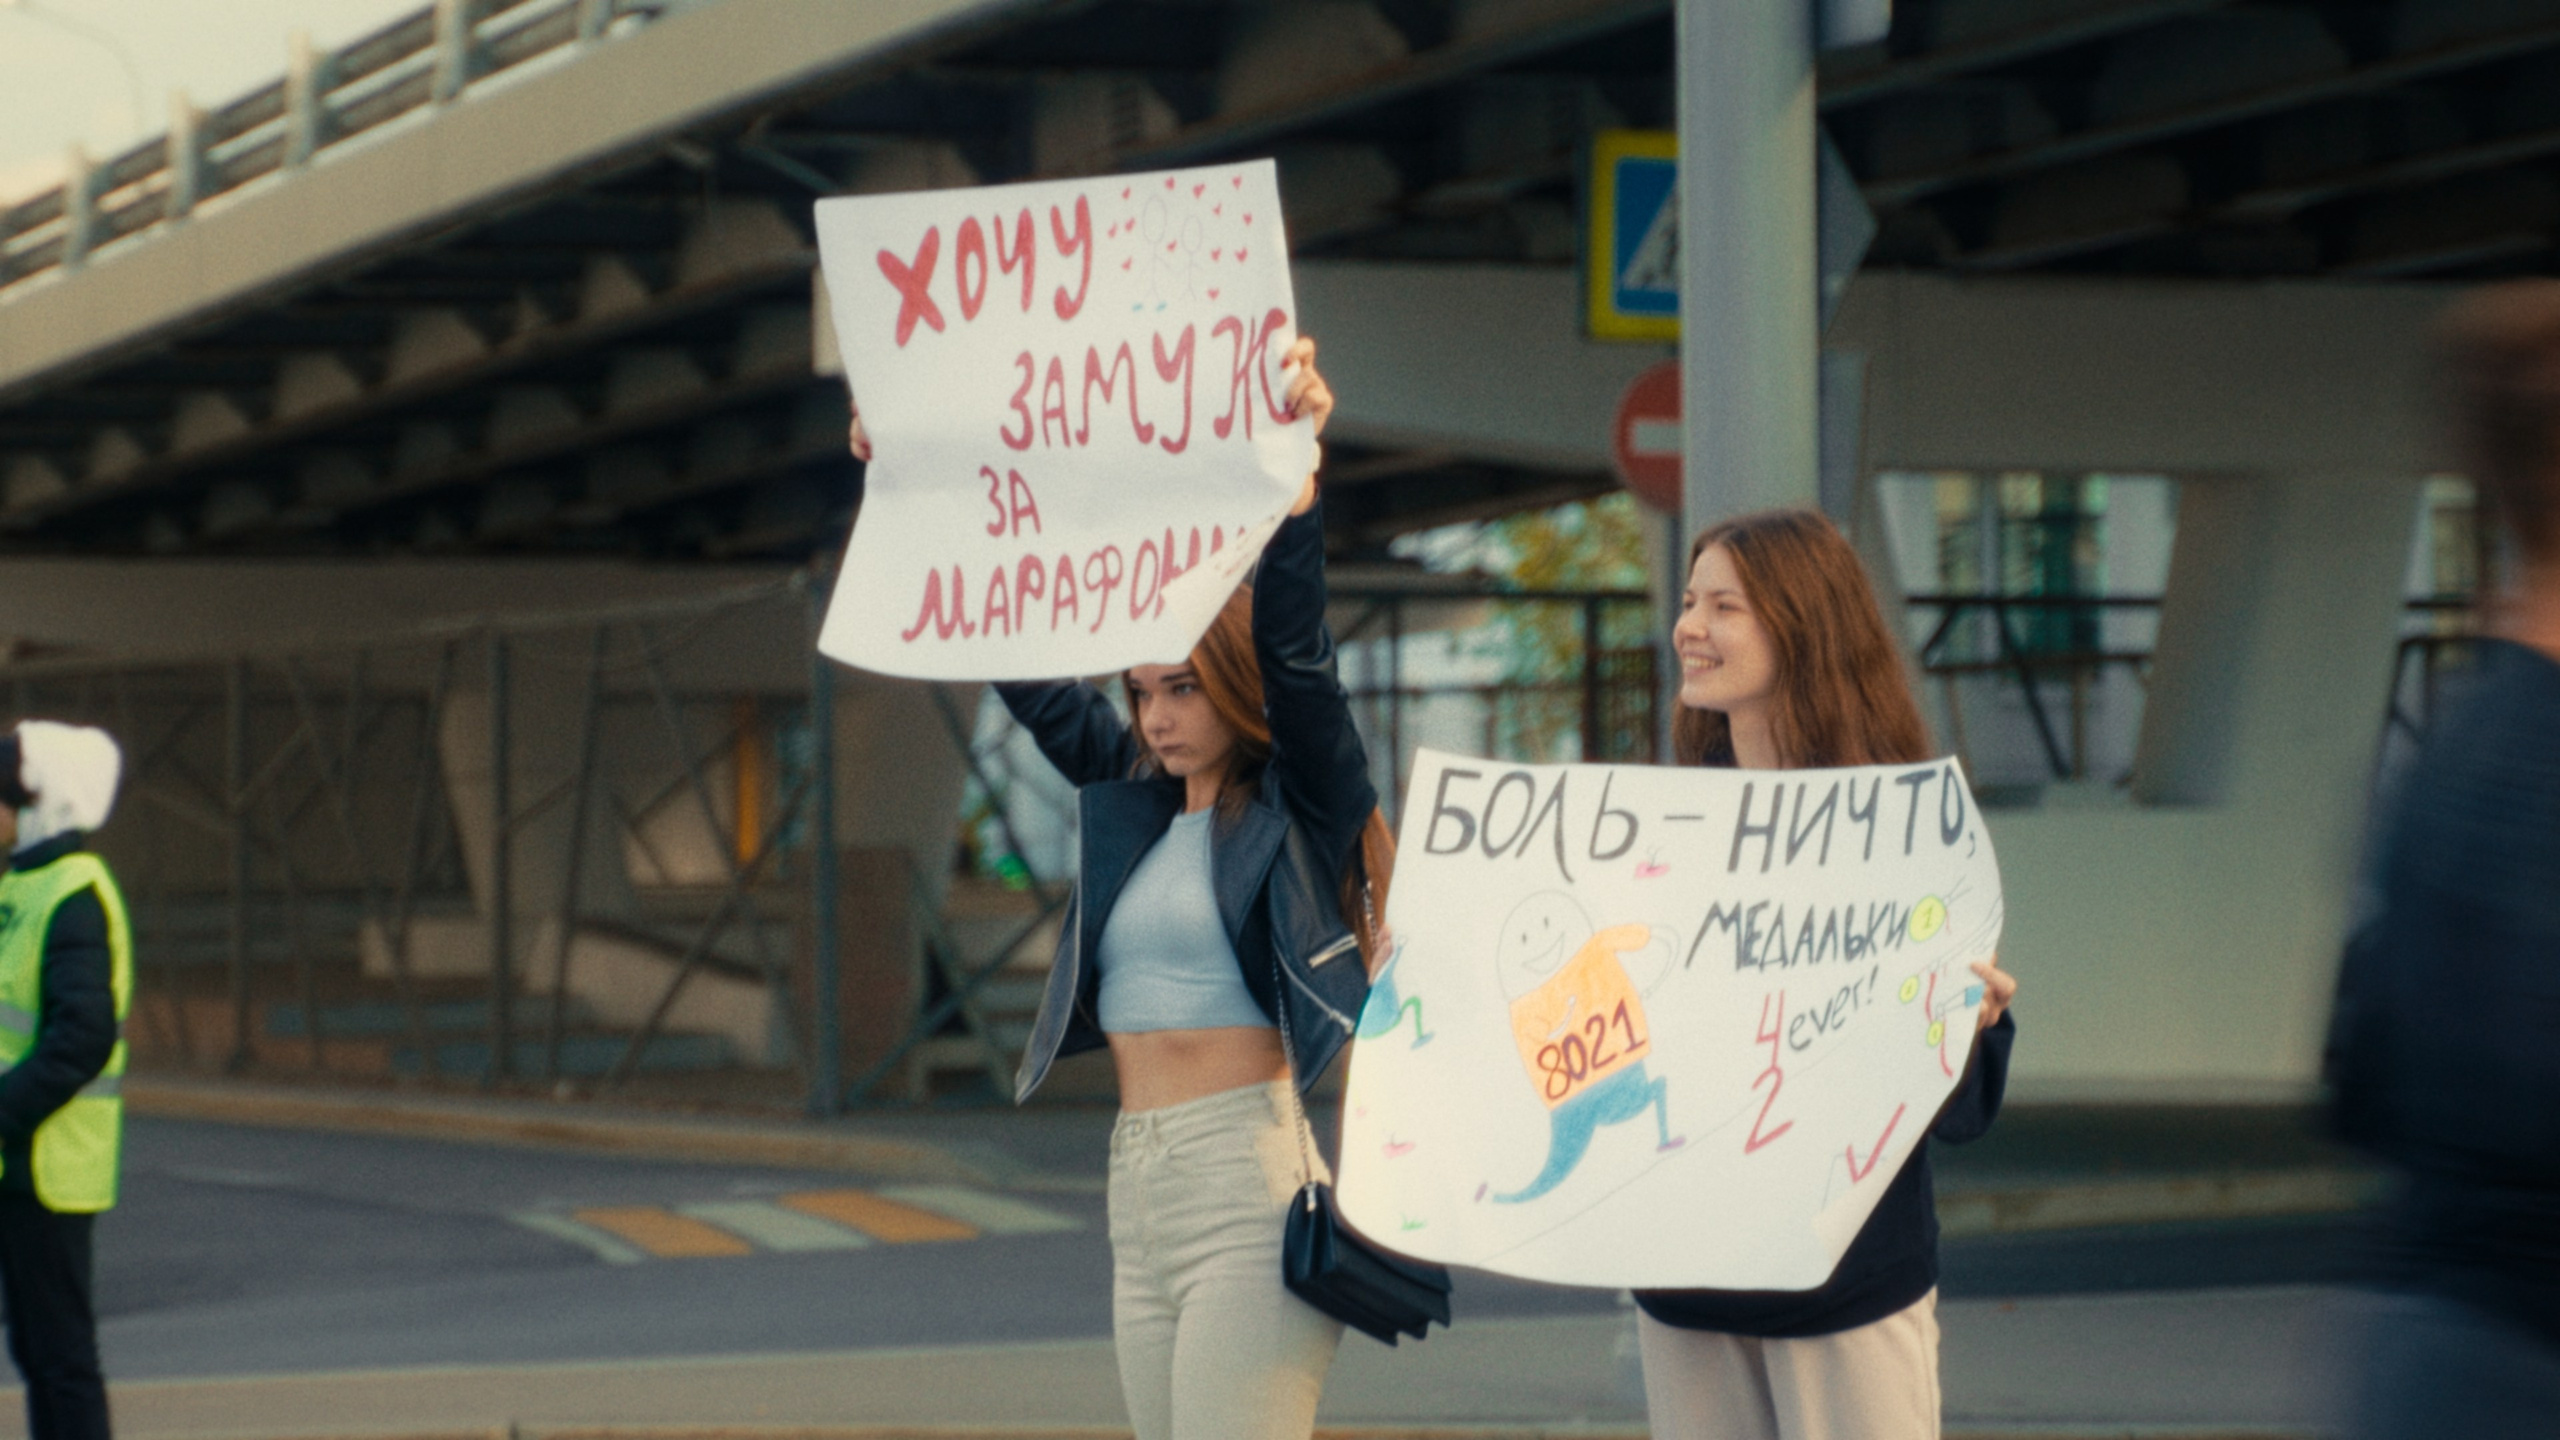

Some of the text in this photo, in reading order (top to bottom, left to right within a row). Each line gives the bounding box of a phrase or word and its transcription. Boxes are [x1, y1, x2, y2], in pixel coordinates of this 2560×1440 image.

[876, 193, 1093, 348] ХОЧУ
[1000, 307, 1298, 455] ЗАМУЖ
[979, 465, 1041, 538] ЗА
[901, 524, 1246, 642] МАРАФОН
[1423, 766, 1640, 883] БОЛЬ
[1727, 764, 1977, 873] НИЧТО,
[1684, 898, 1911, 972] МЕДАЛЬКИ
[1536, 997, 1646, 1100] 8021
